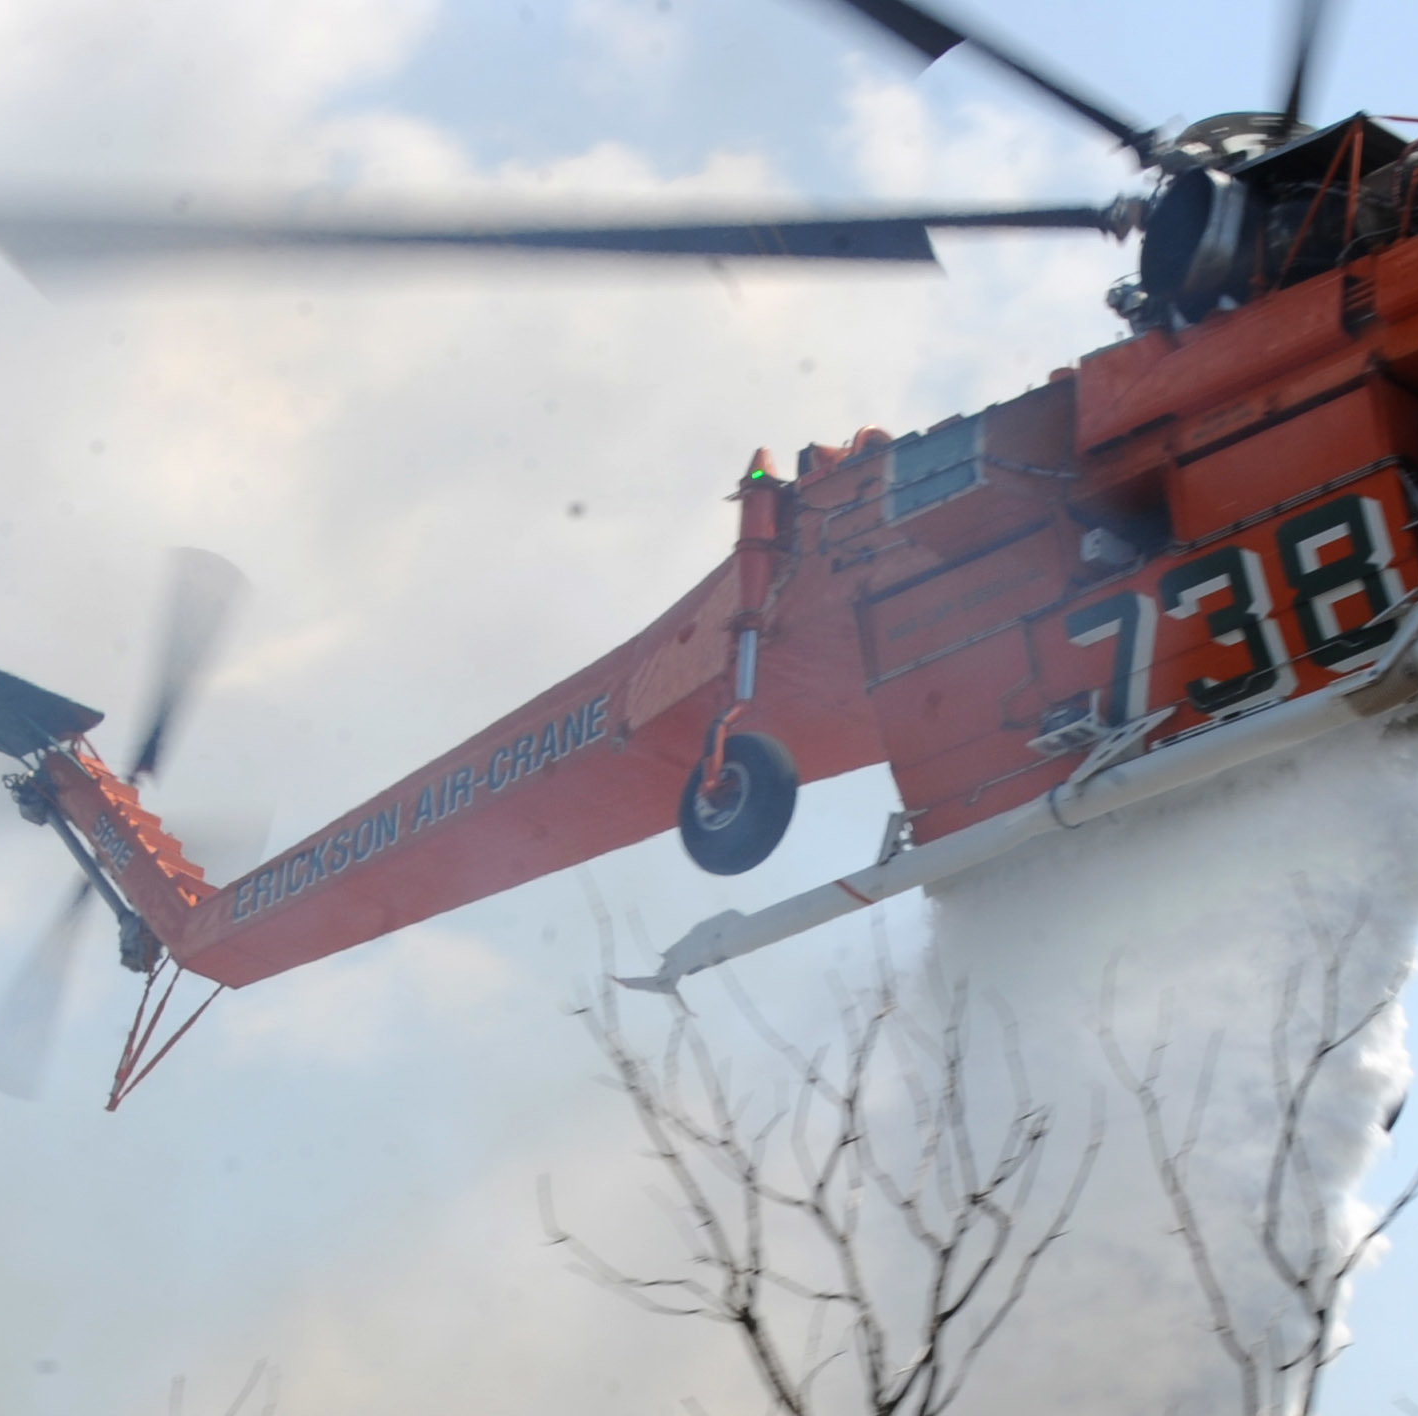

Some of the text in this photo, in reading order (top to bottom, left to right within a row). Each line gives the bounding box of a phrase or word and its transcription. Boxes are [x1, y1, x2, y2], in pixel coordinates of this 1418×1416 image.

[1066, 494, 1405, 752] 738
[232, 693, 611, 925] ERICKSON AIR-CRANE
